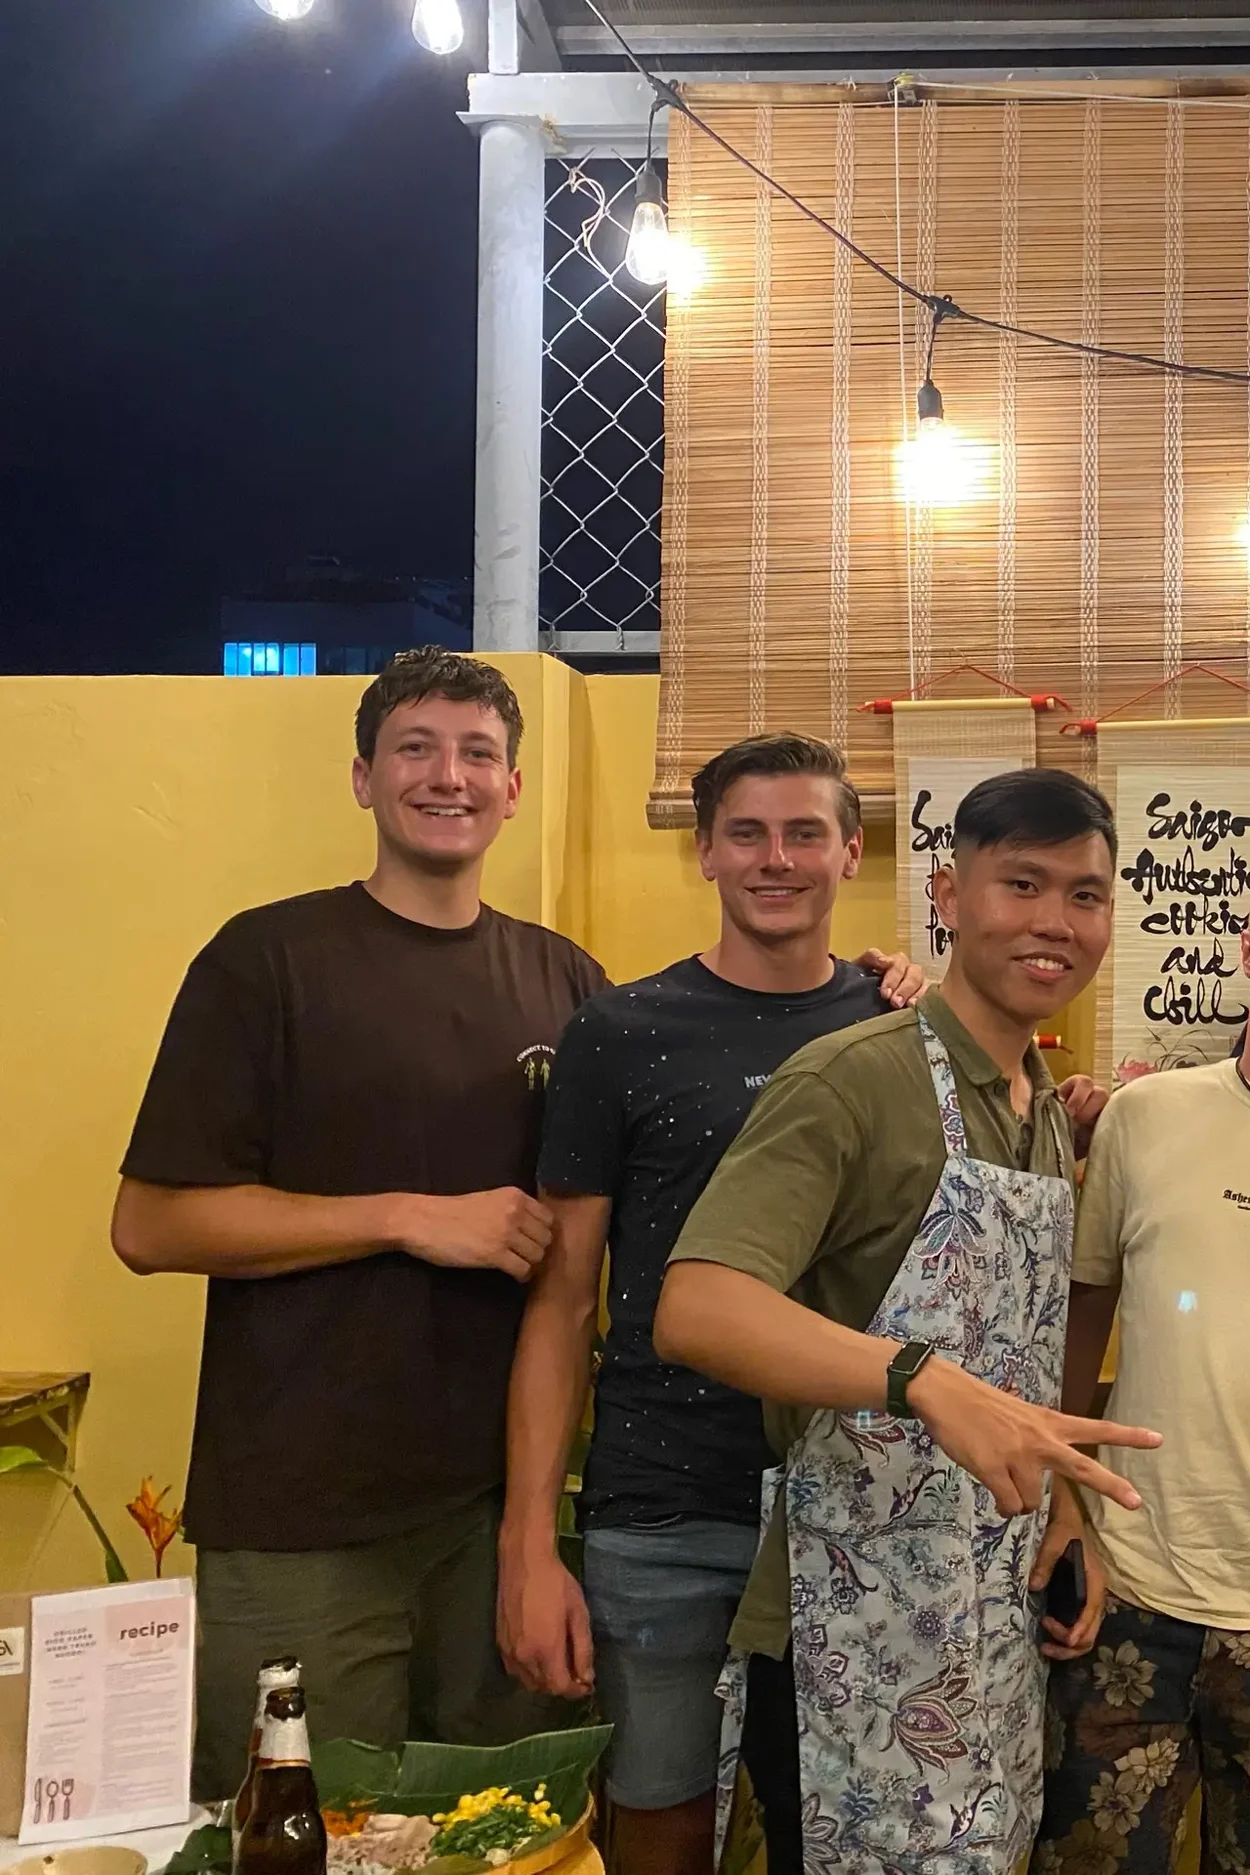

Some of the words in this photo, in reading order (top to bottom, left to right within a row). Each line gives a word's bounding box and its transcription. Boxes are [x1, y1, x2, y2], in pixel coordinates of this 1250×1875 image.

[1161, 937, 1239, 977] and
[1143, 976, 1249, 1025] Chill
[119, 1621, 181, 1642] recipe
